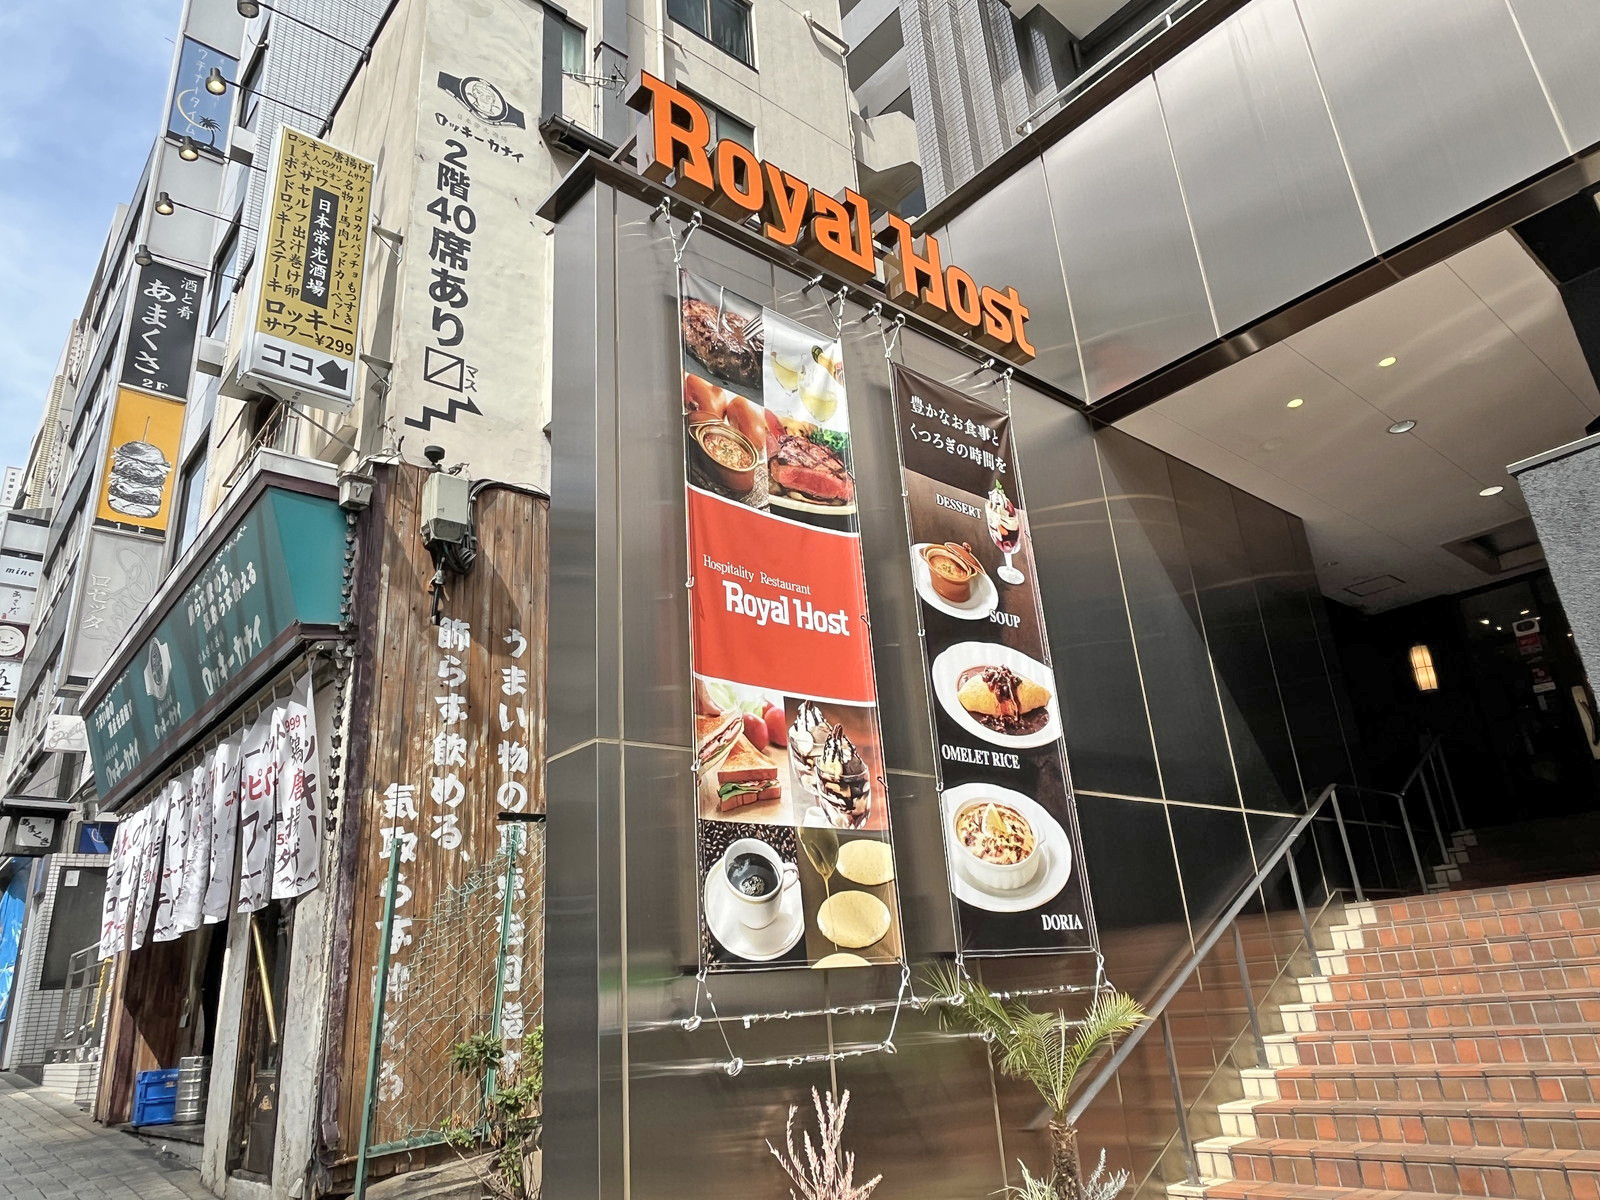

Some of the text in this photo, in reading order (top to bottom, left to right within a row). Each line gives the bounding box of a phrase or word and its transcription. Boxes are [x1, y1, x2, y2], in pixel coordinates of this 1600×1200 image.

[287, 132, 371, 173] ロッキー唐揚げ
[435, 112, 524, 163] ロッキーカナイ
[300, 170, 341, 191] サワー
[640, 69, 1036, 360] Royal Host
[306, 198, 332, 297] 日本栄光酒場
[177, 277, 197, 320] 酒と肴
[265, 298, 354, 335] ロッキー
[134, 279, 177, 375] あまくさ
[261, 343, 314, 376] ココ
[464, 364, 479, 393] マス
[142, 378, 168, 391] 2F
[910, 396, 999, 446] 豊かなお食事と
[910, 422, 1007, 473] くつろぎの時間を
[936, 493, 982, 519] DESSERT
[5, 566, 35, 577] mine
[703, 553, 811, 596] Hospitality Restaurant
[722, 580, 850, 637] Royal Host
[989, 609, 1021, 628] SOUP
[941, 743, 1021, 769] OMELET RICE
[1041, 914, 1084, 930] DORIA
